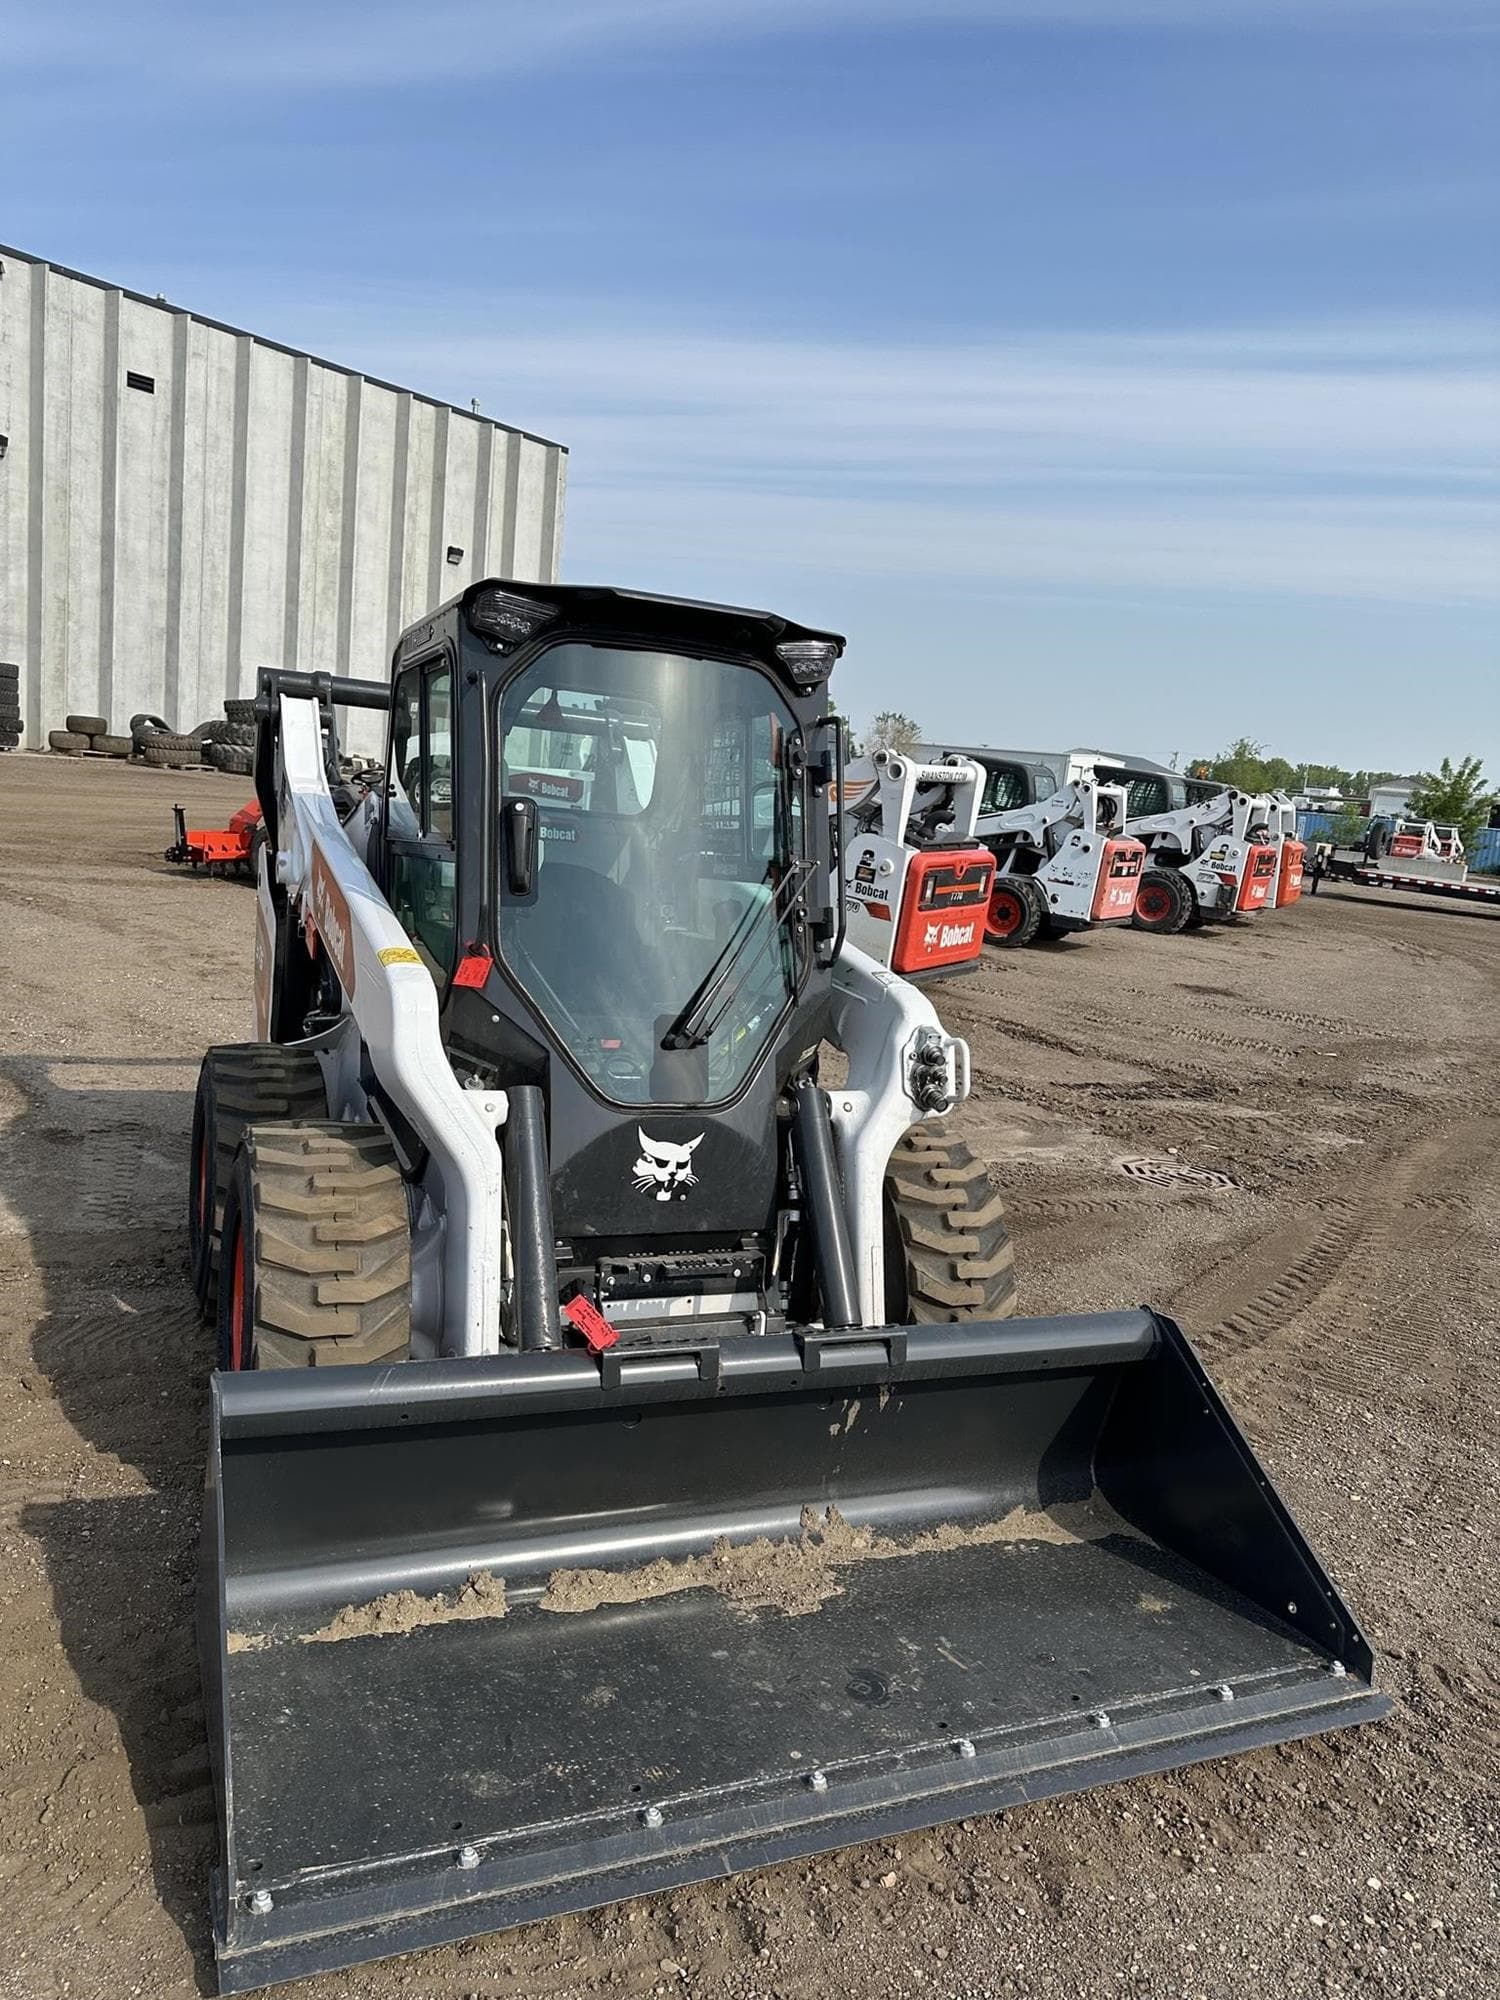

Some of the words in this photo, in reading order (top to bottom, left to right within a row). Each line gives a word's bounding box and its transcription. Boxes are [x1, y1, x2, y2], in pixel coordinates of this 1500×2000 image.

[541, 781, 570, 799] Bobcat
[539, 826, 576, 841] Bobcat
[1210, 861, 1237, 873] Bobcat
[854, 881, 889, 901] Bobcat
[939, 921, 975, 949] Bobcat
